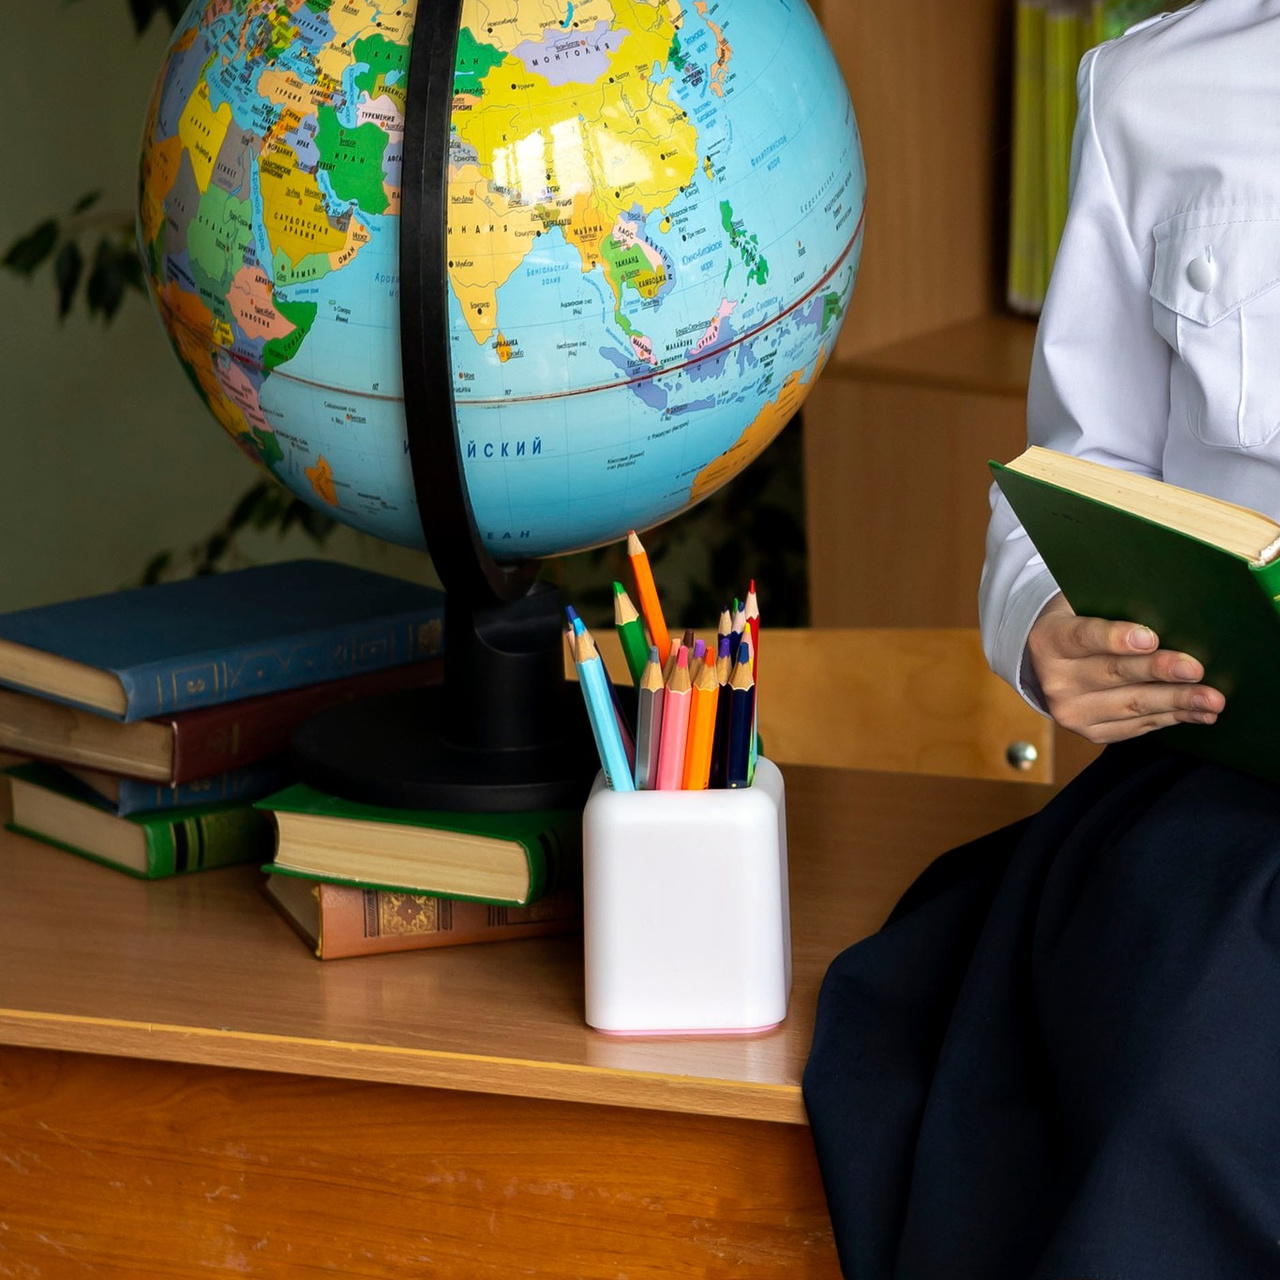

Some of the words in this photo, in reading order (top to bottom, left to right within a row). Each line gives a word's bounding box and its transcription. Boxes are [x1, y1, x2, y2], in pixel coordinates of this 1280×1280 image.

[532, 42, 610, 66] МОНГОЛИЯ
[361, 111, 396, 122] ТУРКМЕНИЯ
[296, 139, 310, 149] ИРАК
[334, 153, 365, 164] ИРАН
[273, 211, 329, 236] САУДОВСКАЯ
[448, 224, 508, 235] ИНДИЯ
[283, 226, 316, 241] АРАВИЯ
[618, 226, 634, 239] ЛАОС
[337, 246, 356, 264] ОМАН
[700, 260, 714, 272] море
[638, 274, 667, 288] КАМБОДЖА
[665, 338, 693, 351] МАЛАЙЗИЯ
[660, 353, 683, 365] СИНГАПУР
